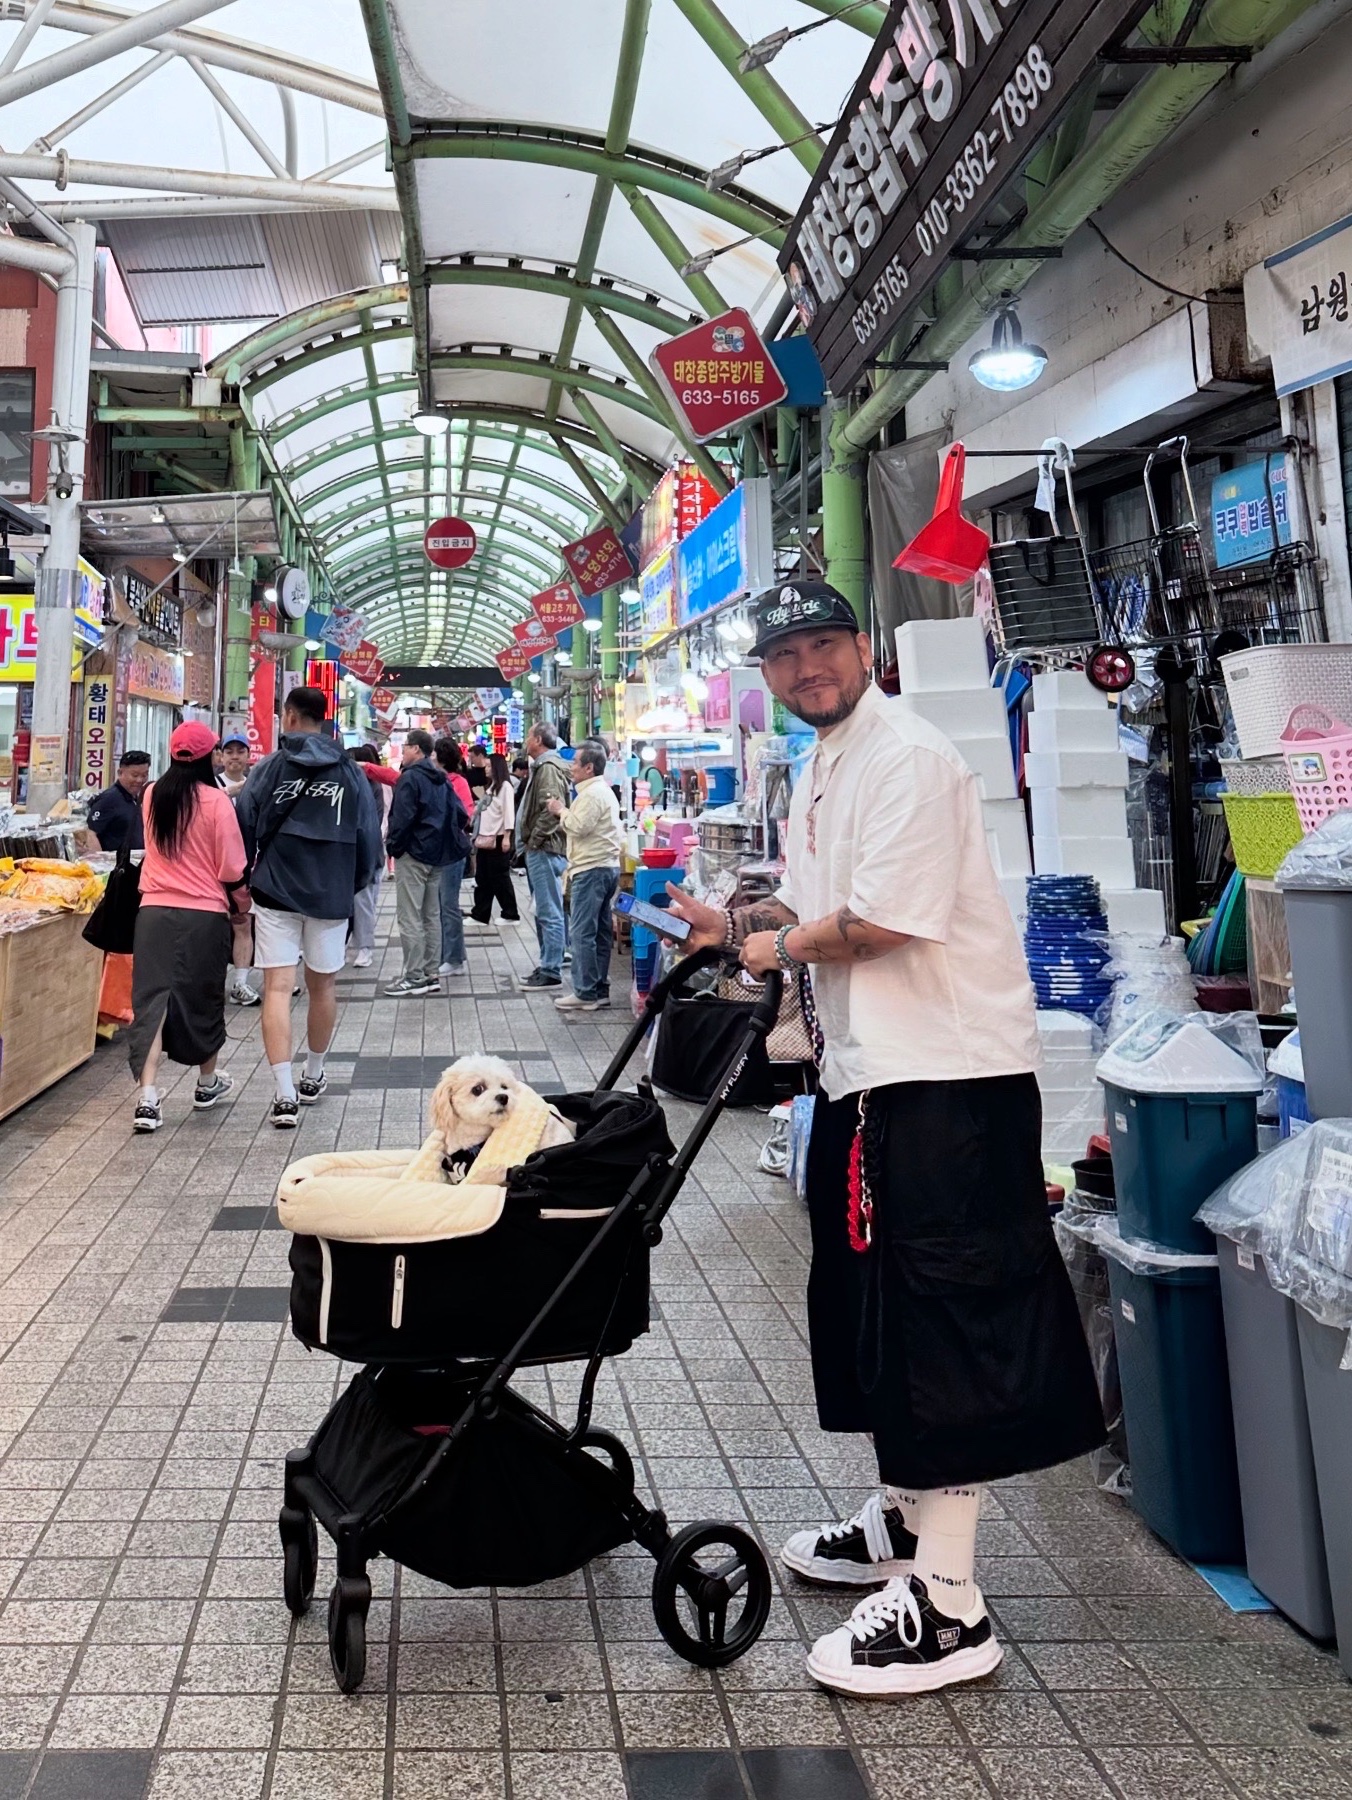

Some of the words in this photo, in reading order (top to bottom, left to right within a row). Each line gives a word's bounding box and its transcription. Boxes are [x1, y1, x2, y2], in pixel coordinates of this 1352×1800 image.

[852, 255, 909, 345] 633-5165
[915, 43, 1052, 257] 010-3362-7898
[674, 360, 765, 384] 태창종합주방기물
[682, 390, 760, 405] 633-5165
[682, 481, 705, 538] 가자미식
[432, 539, 470, 548] 진입금지
[720, 1085, 730, 1100] MY
[728, 1053, 748, 1086] FLUFFY
[932, 1573, 967, 1586] RIGHT
